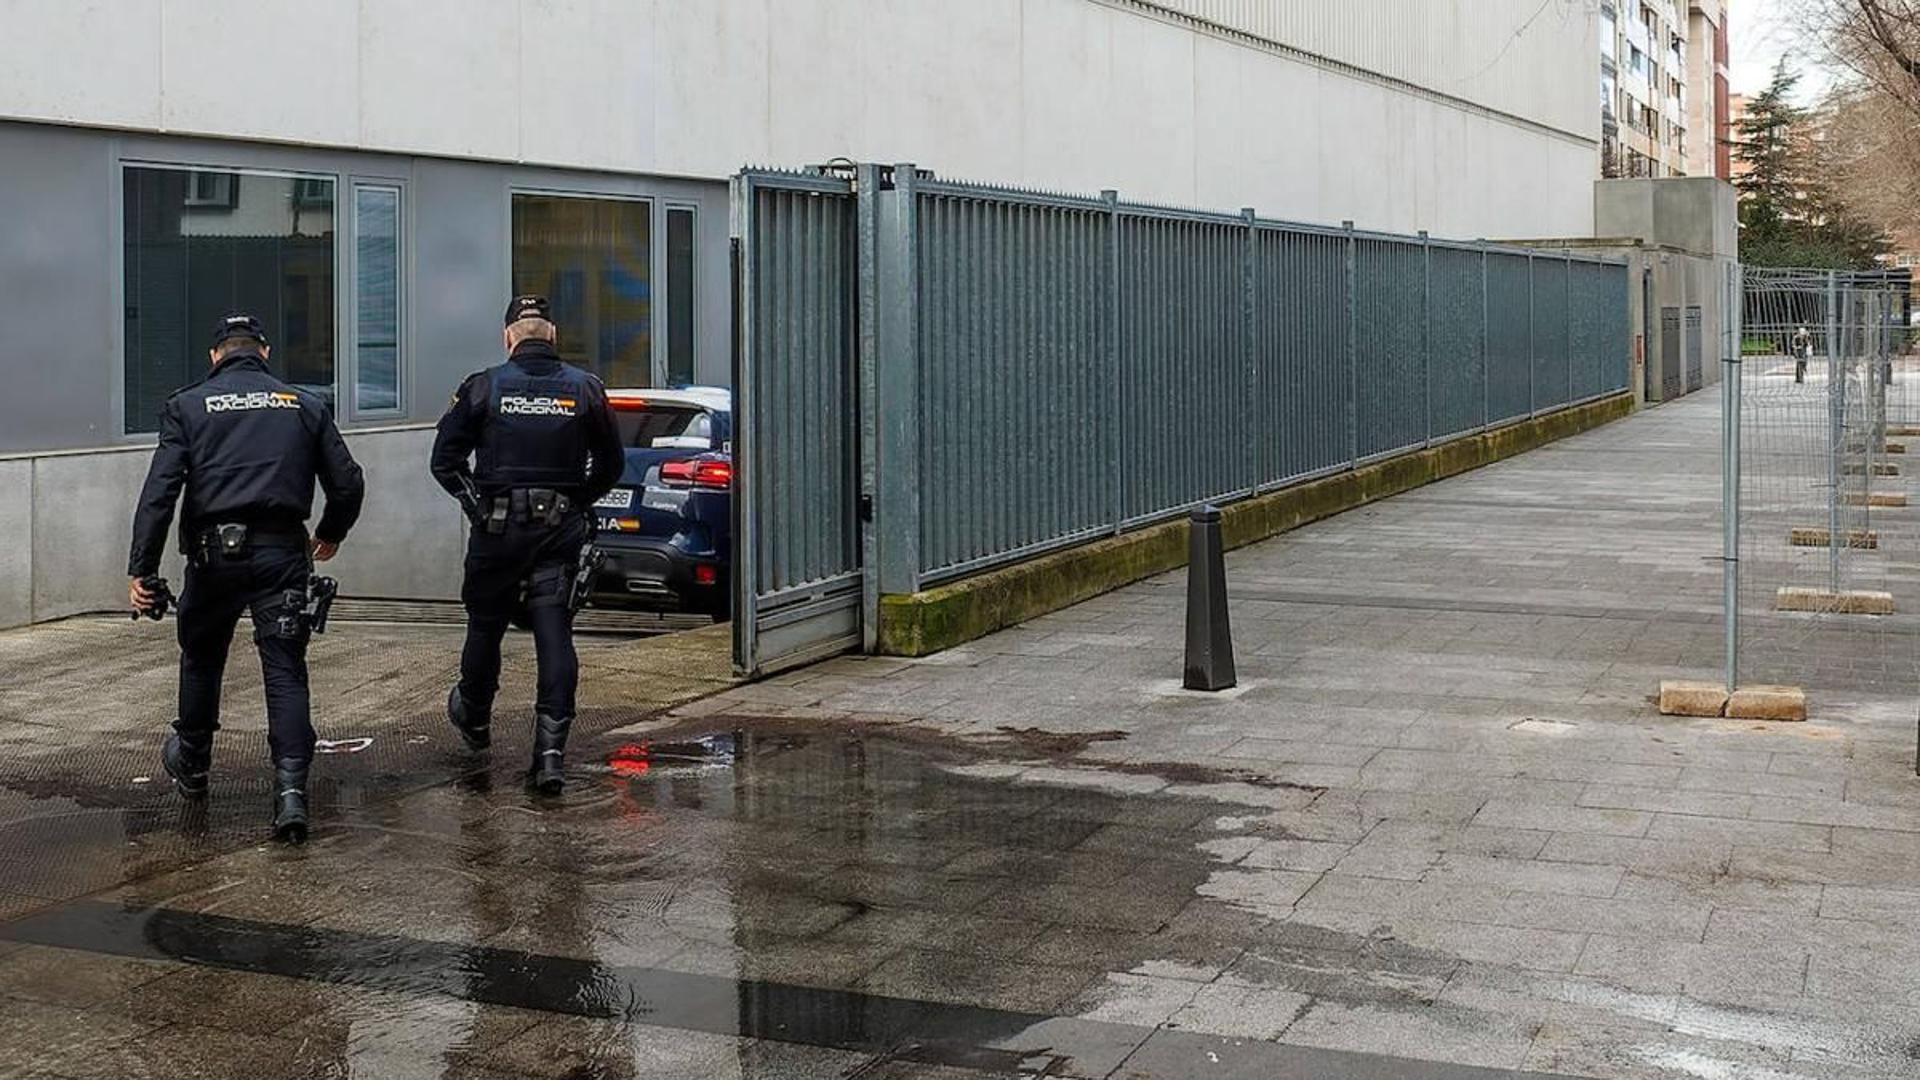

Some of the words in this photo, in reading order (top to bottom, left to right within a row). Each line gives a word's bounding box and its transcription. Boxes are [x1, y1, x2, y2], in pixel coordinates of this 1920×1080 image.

[205, 392, 278, 403] POLICIA
[501, 396, 560, 406] POLICIA
[207, 399, 301, 413] NACIONAL
[500, 405, 576, 416] NACIONAL
